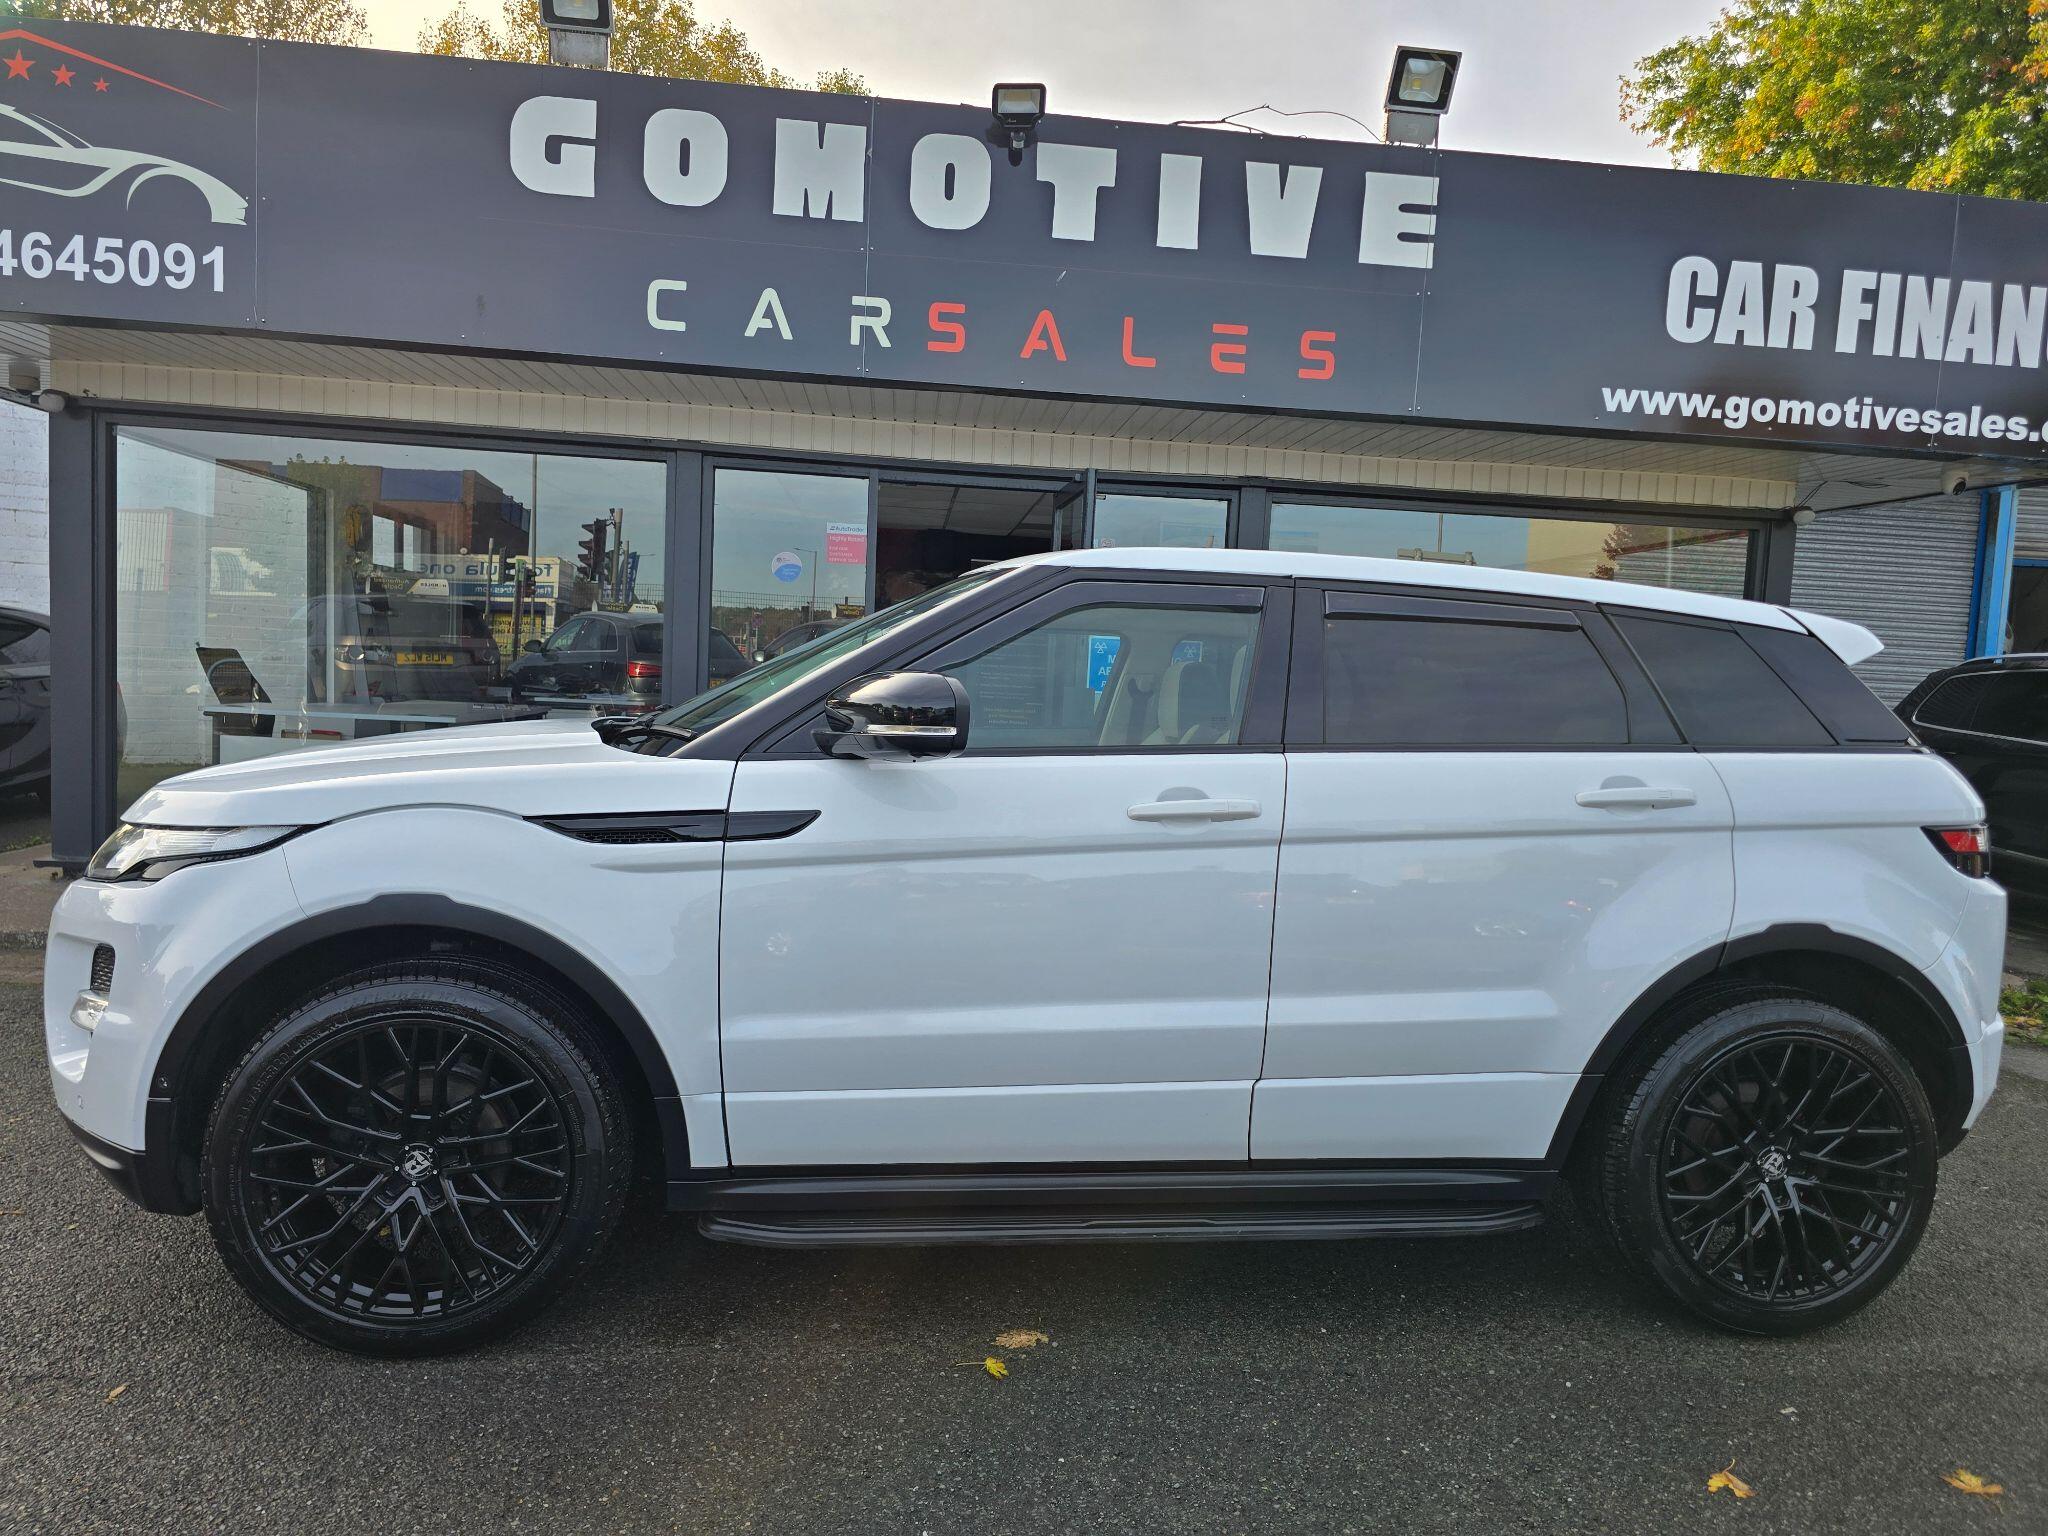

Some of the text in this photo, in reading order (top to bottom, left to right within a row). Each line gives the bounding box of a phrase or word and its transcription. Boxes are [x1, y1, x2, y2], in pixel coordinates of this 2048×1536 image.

[510, 95, 1440, 269] GOMOTIVE
[0, 229, 224, 292] 4645091
[1666, 255, 2048, 369] CAR FINAN
[1601, 386, 2048, 444] www.gomotivesales.
